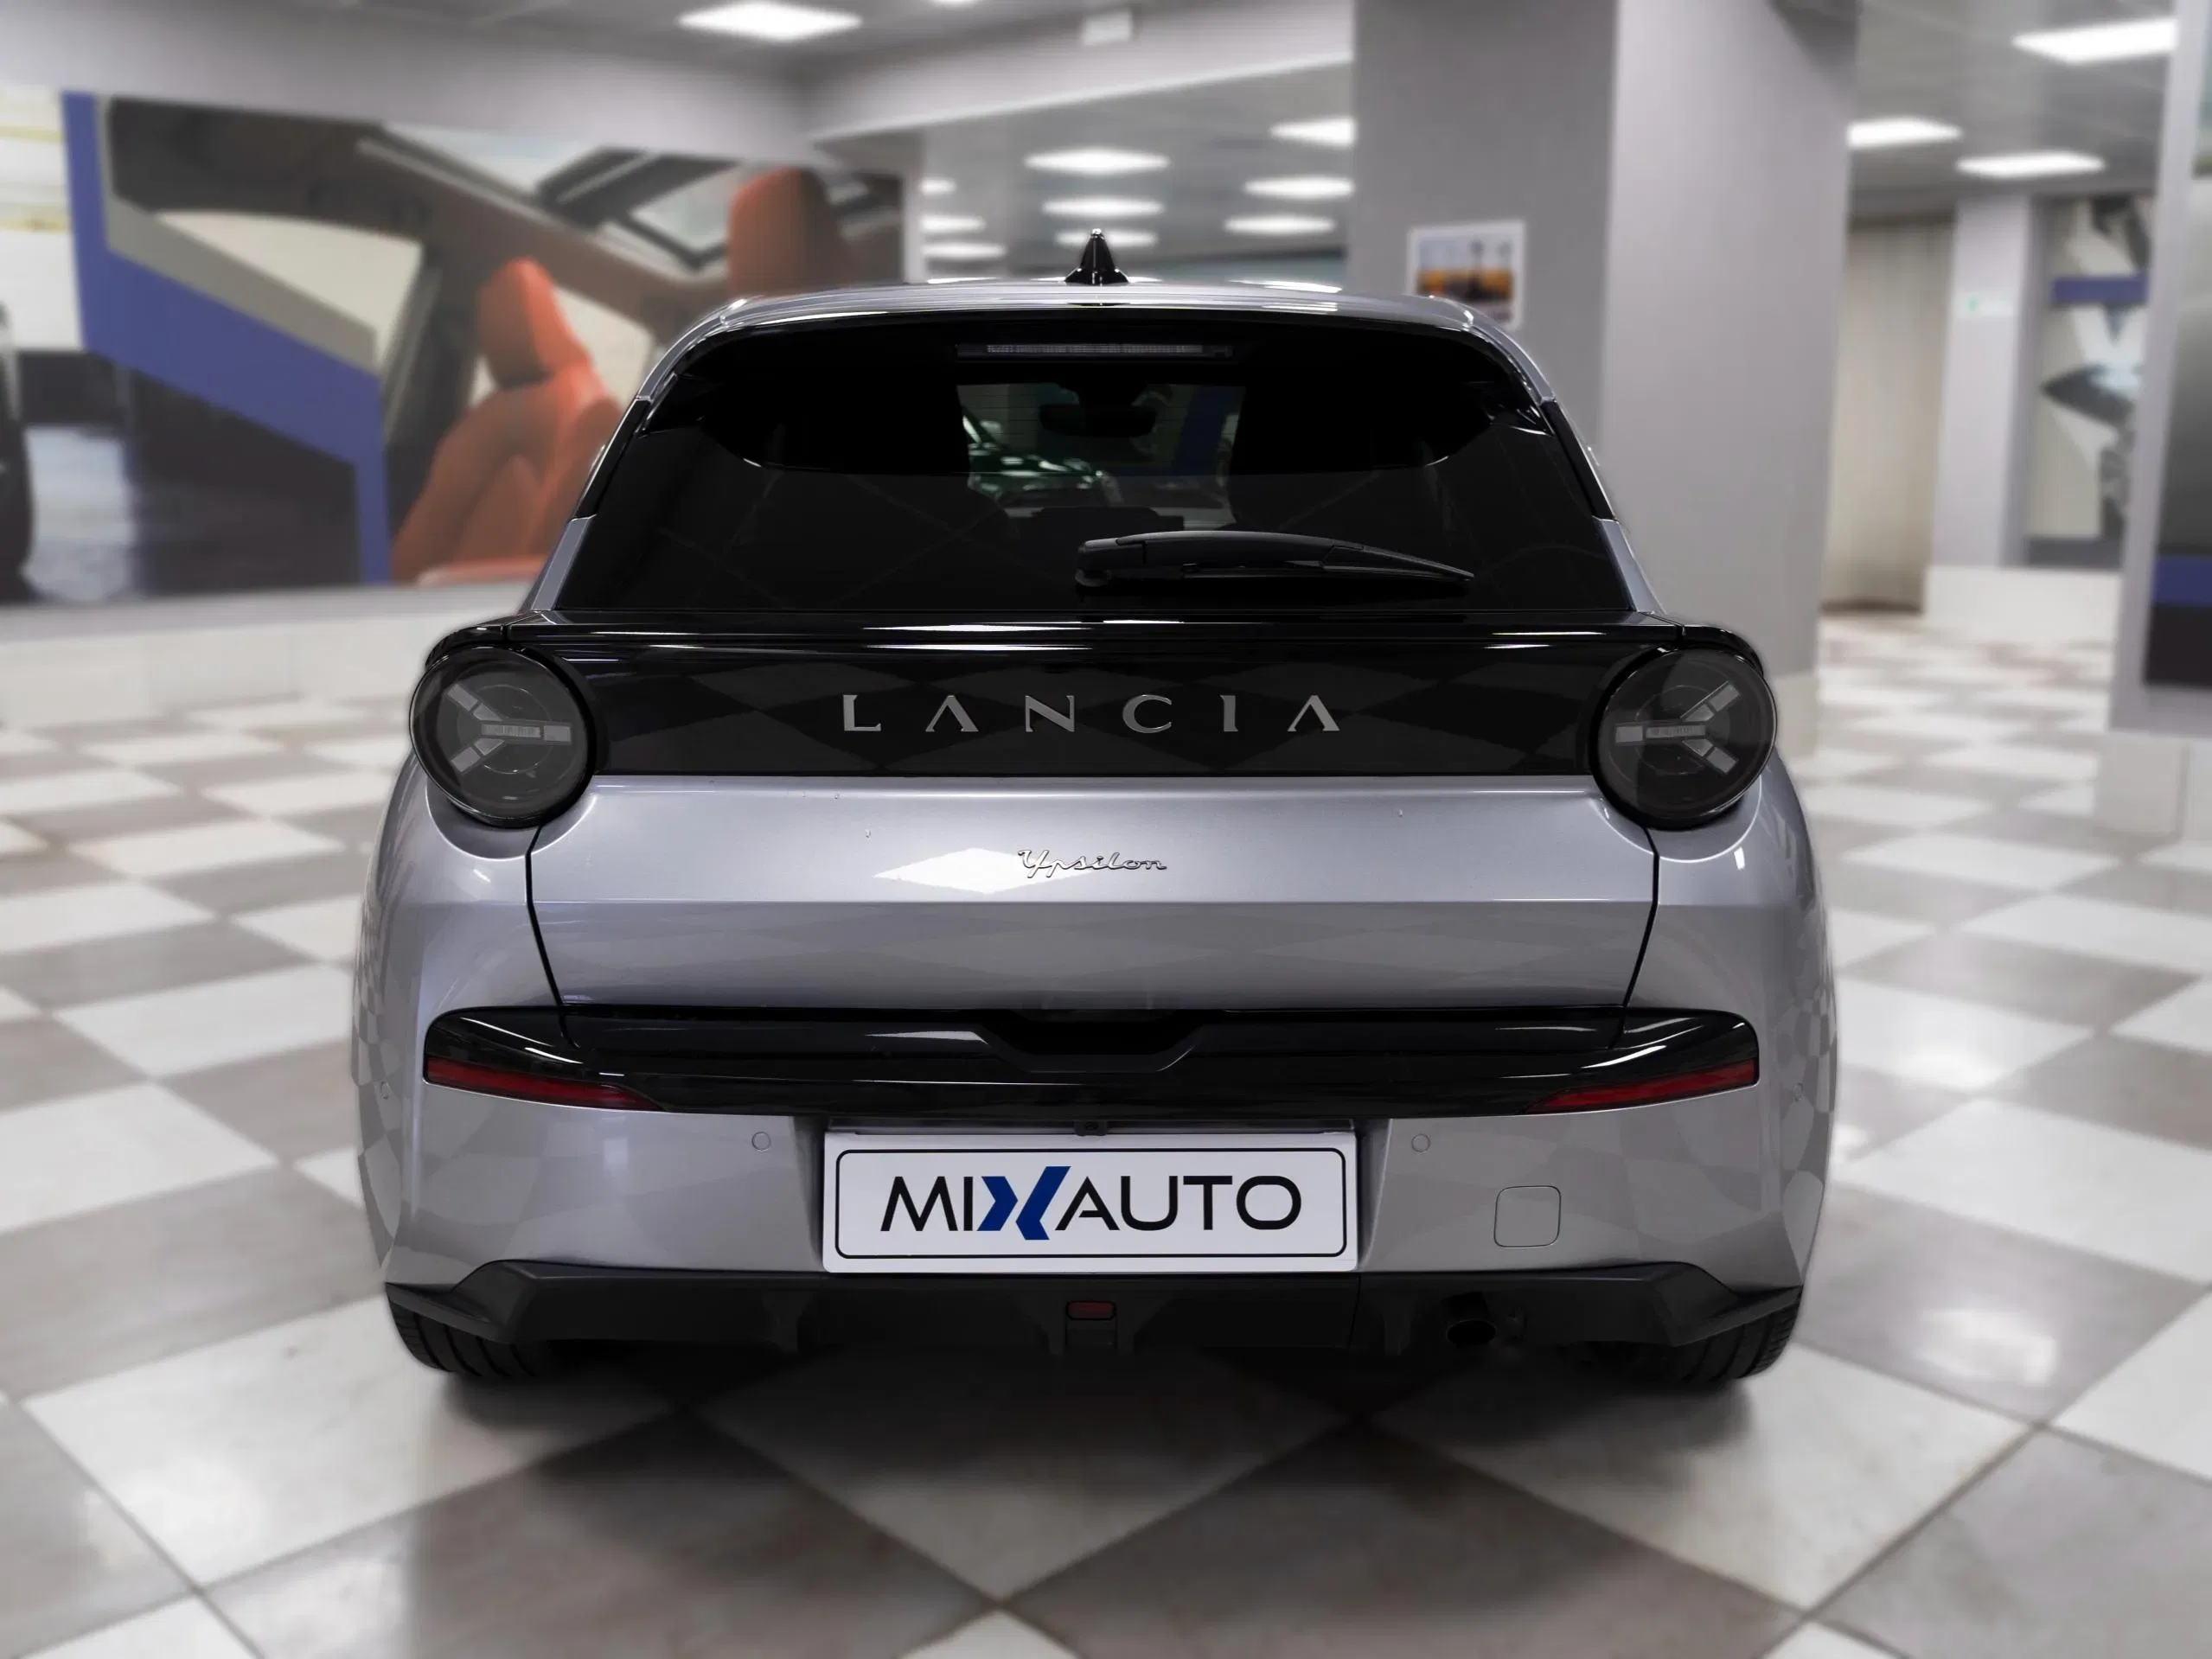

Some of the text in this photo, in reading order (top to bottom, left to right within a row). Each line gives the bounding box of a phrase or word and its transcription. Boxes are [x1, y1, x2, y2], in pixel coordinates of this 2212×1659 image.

[842, 693, 1340, 733] LANCIA
[1018, 849, 1167, 877] Ypsilon
[879, 1165, 1302, 1241] MIXAUTO
